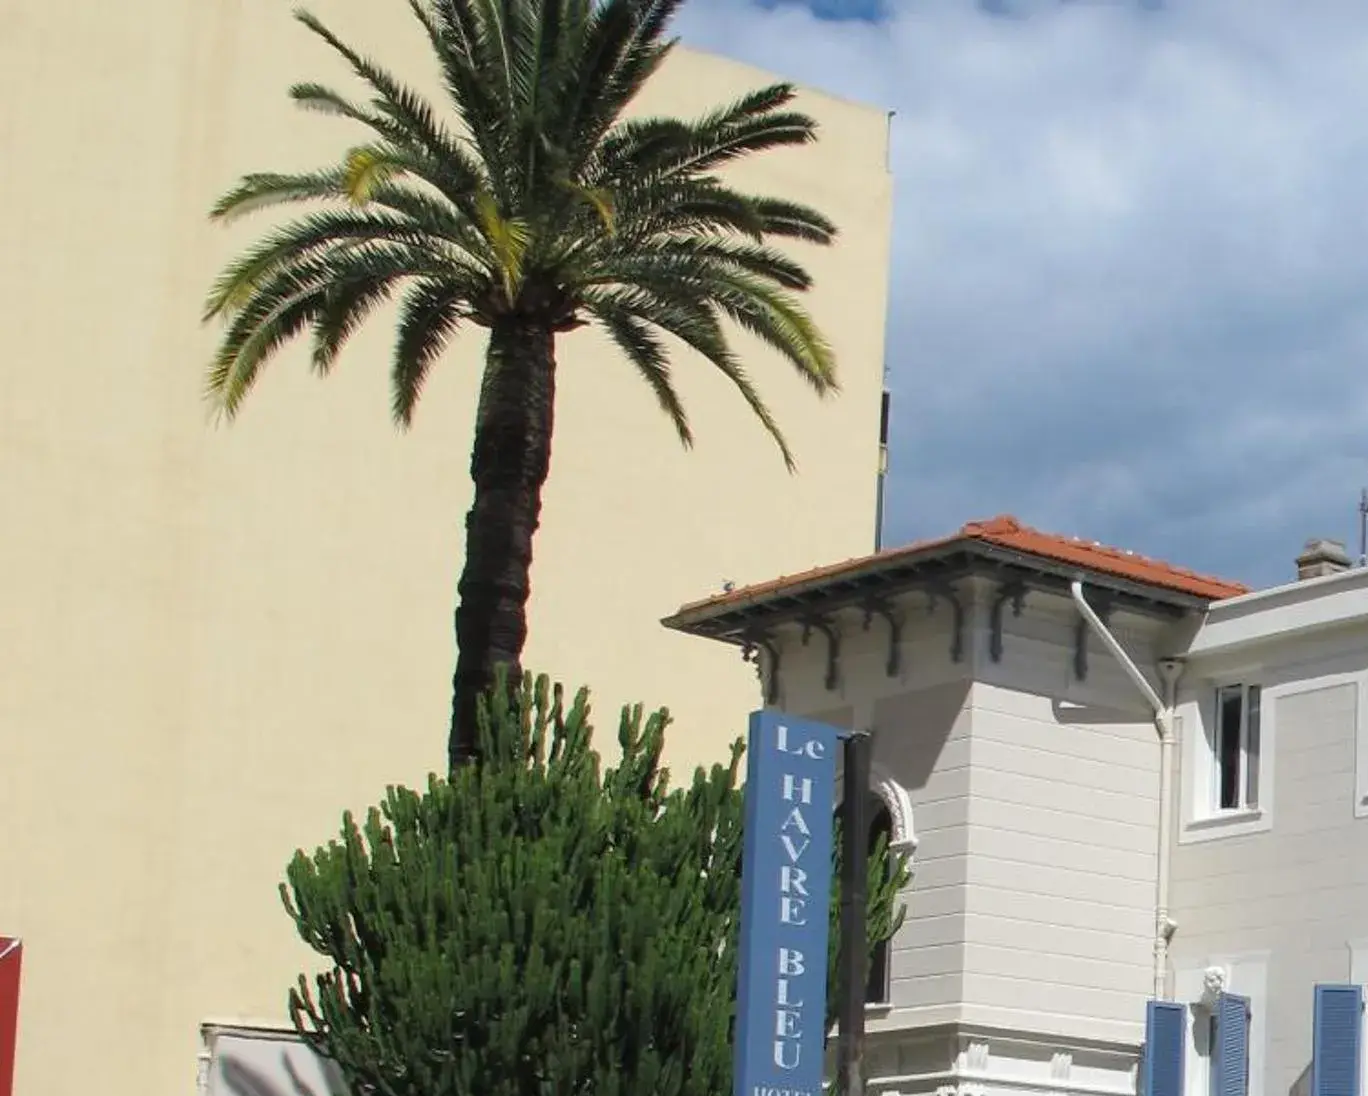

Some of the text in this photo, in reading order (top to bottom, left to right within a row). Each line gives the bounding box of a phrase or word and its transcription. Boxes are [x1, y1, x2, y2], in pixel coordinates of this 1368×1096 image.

[774, 725, 825, 1071] Le HAVRE BLEU
